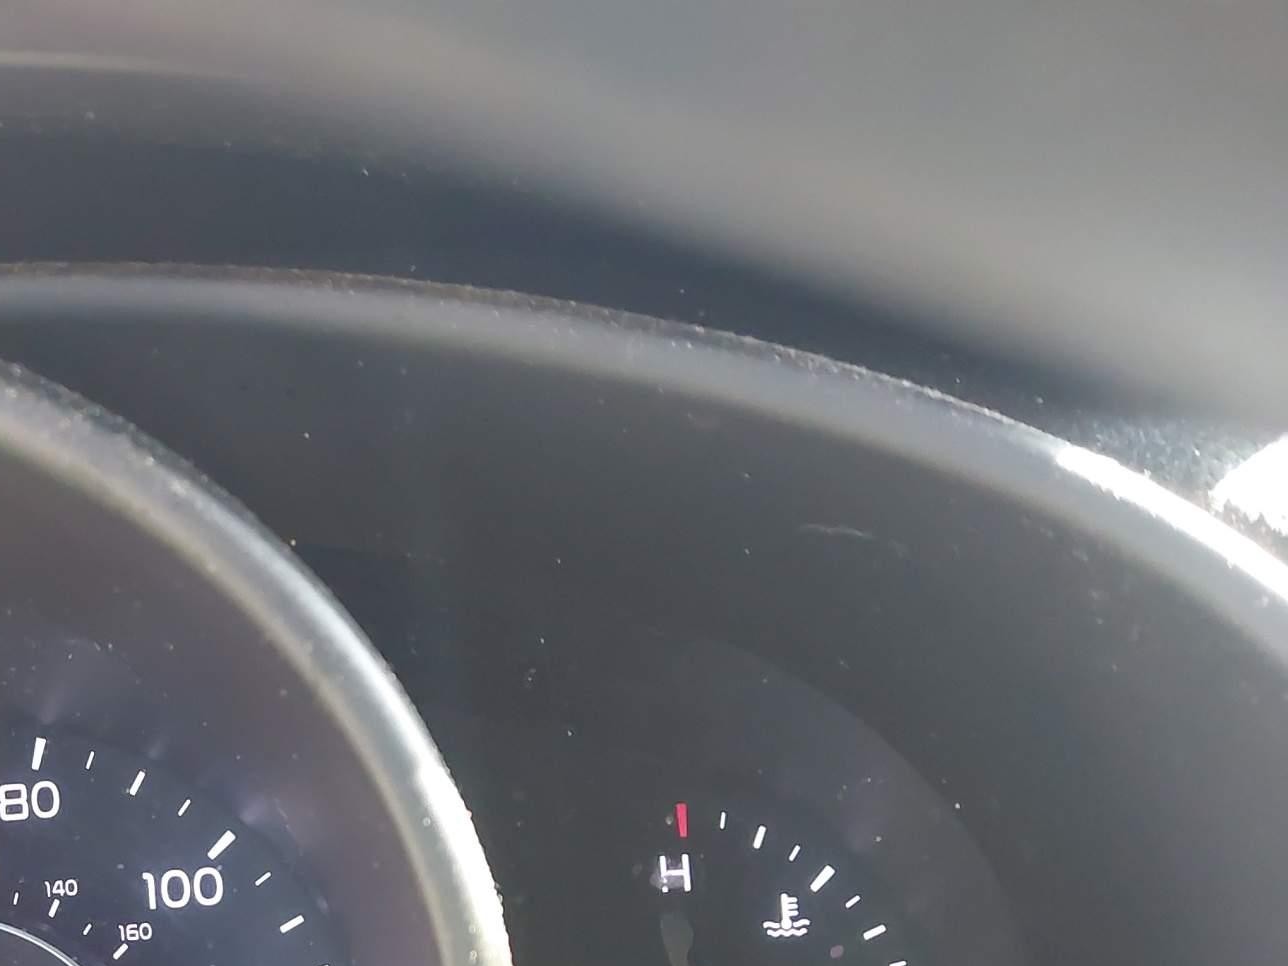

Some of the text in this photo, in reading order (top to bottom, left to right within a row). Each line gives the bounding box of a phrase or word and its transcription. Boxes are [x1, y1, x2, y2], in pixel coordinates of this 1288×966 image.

[44, 878, 78, 898] 140
[142, 866, 224, 910] 100
[659, 853, 692, 893] H
[118, 922, 153, 941] 160
